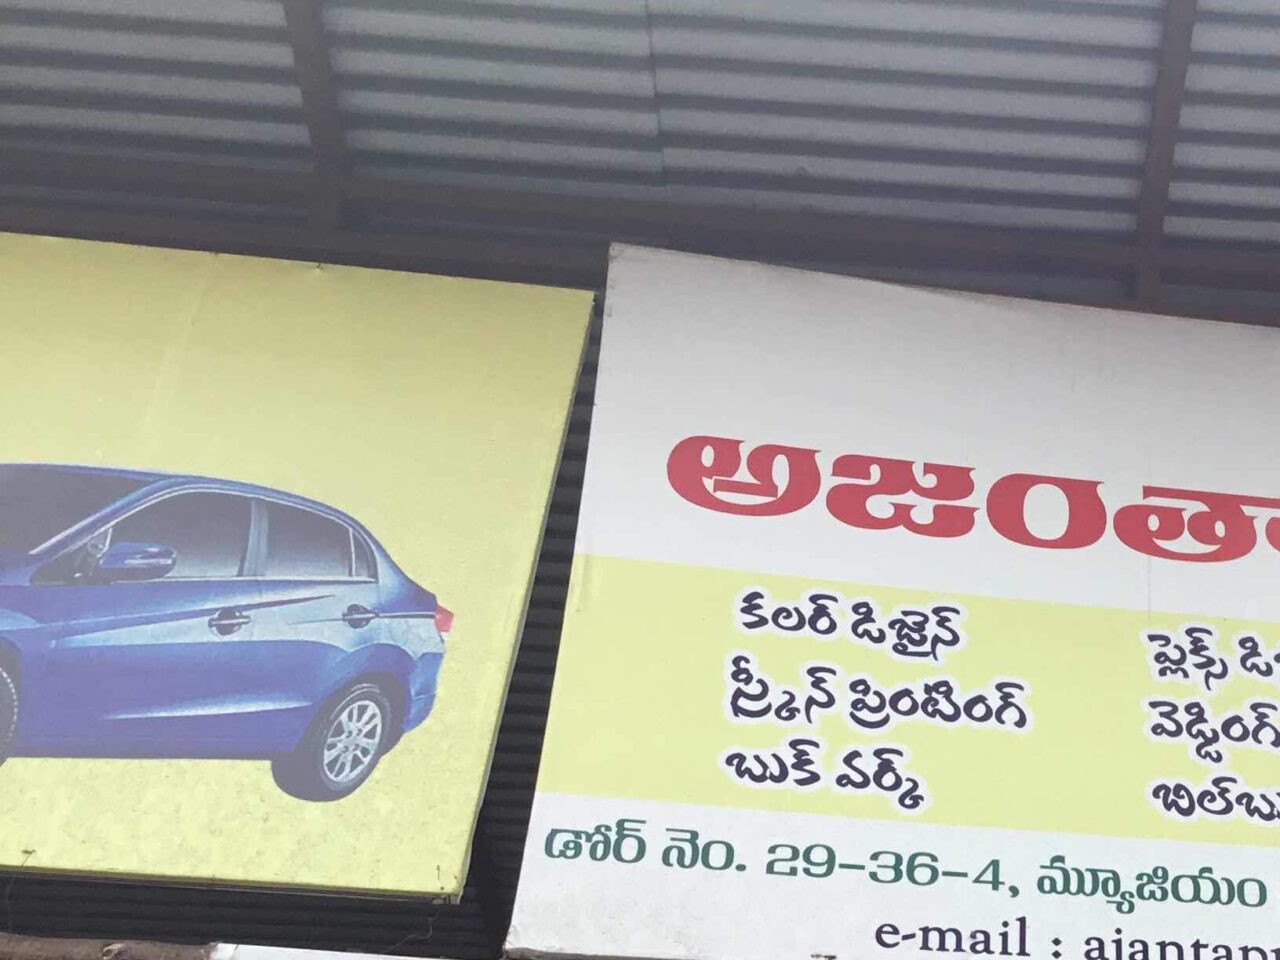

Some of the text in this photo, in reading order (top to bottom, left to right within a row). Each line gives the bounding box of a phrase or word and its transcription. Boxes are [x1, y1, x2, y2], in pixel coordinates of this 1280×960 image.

[740, 591, 961, 661] కలర్ డిజైన్
[849, 678, 1027, 729] ప్రింటింగ్
[725, 738, 924, 809] బుక్ వర్క్
[544, 818, 646, 863] డోర్
[661, 828, 746, 872] నెం.
[875, 916, 1031, 957] e-mail
